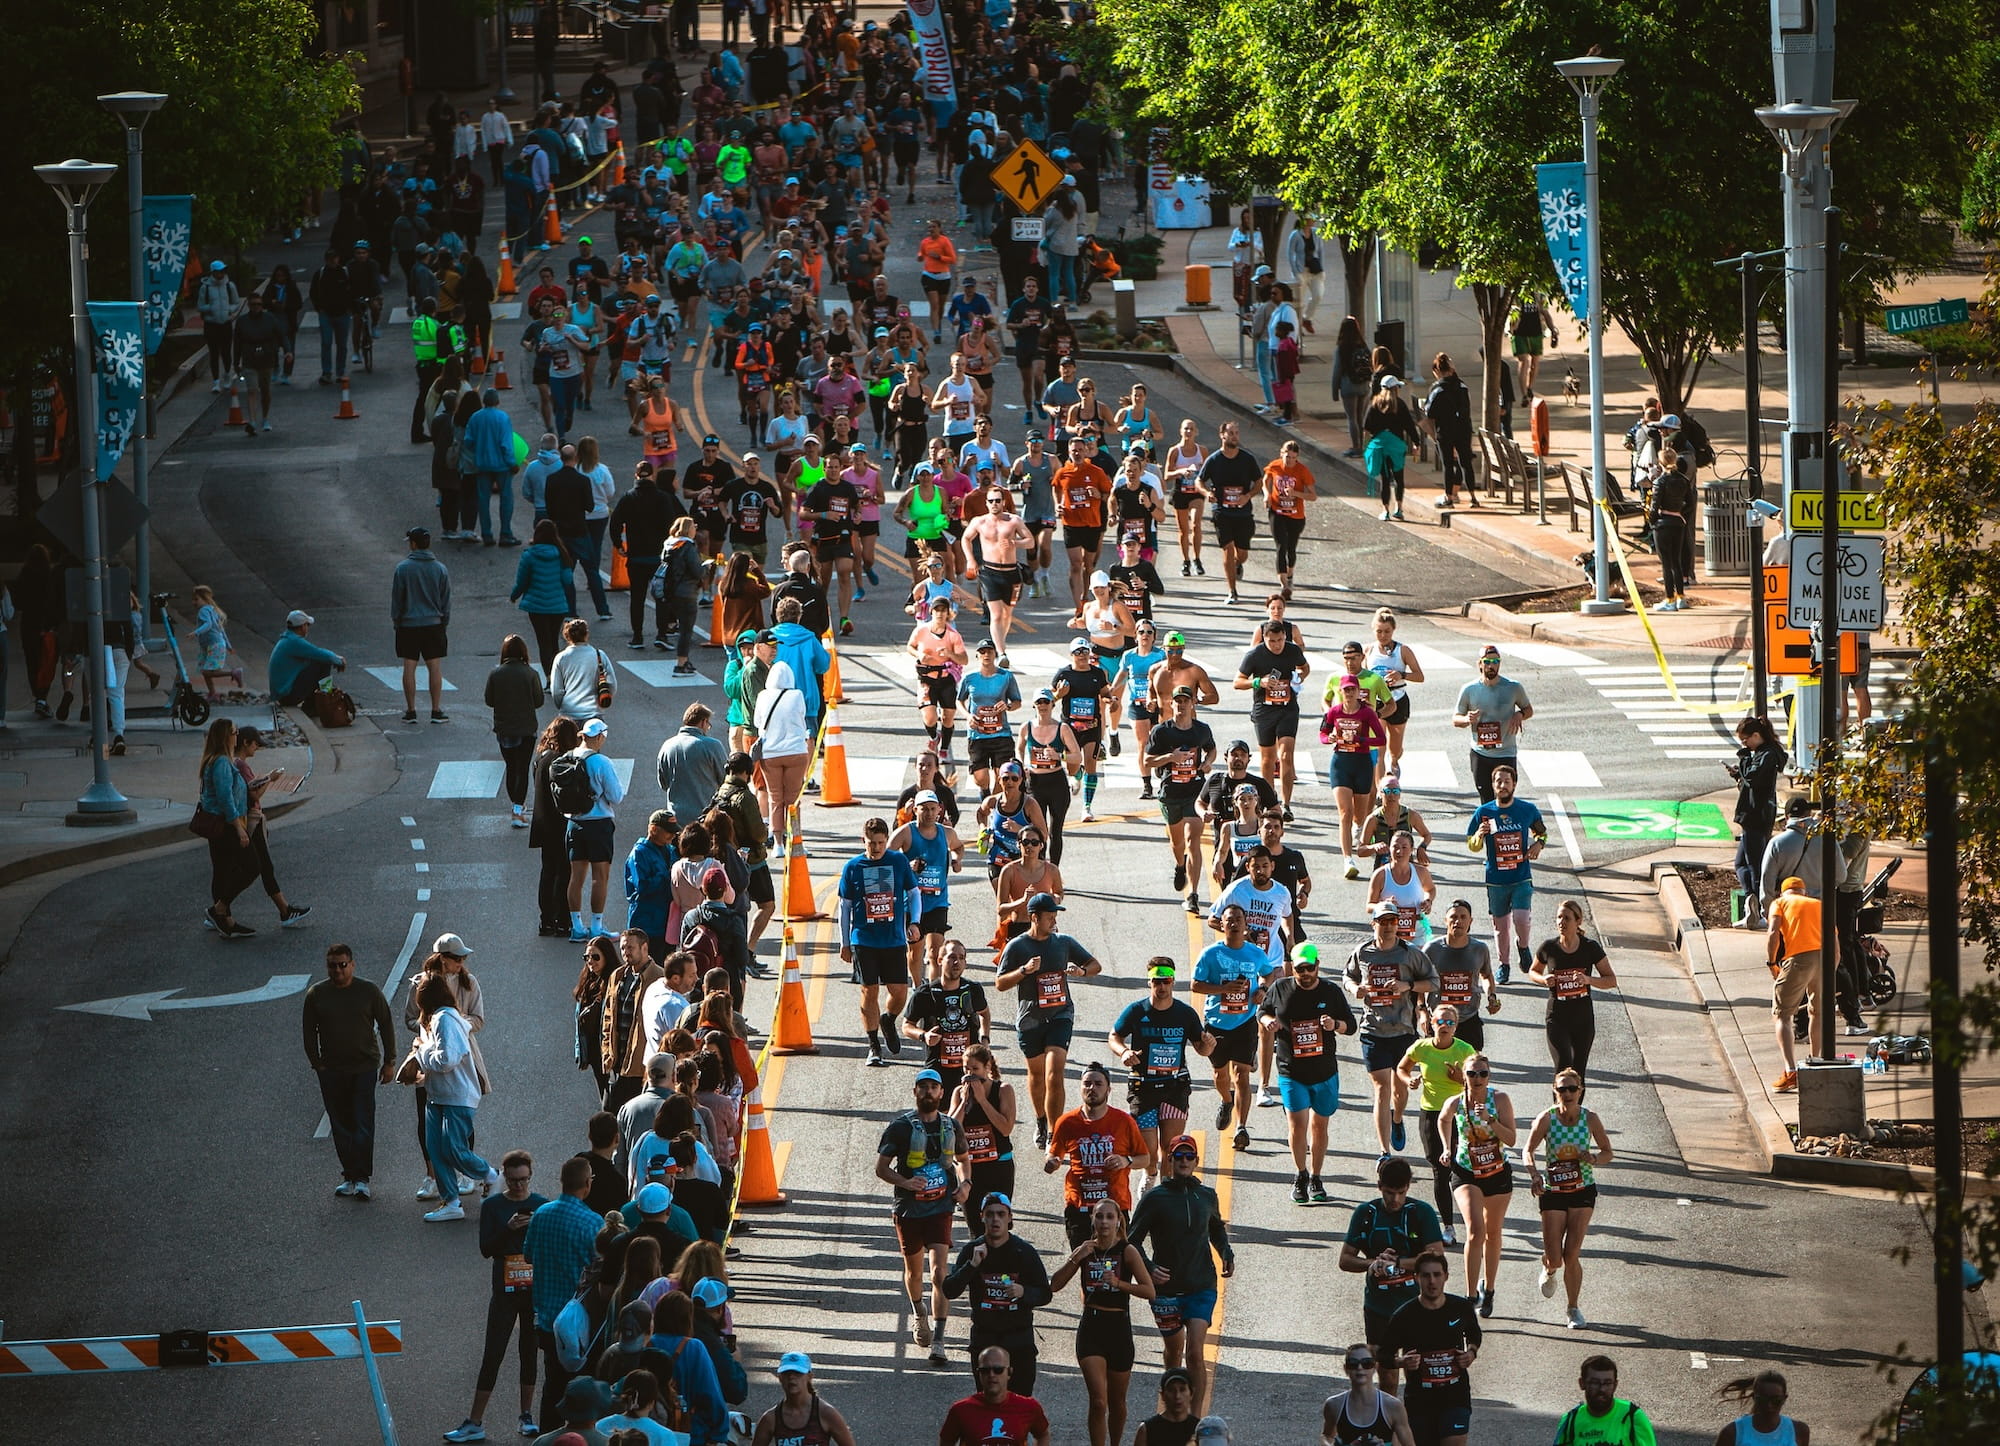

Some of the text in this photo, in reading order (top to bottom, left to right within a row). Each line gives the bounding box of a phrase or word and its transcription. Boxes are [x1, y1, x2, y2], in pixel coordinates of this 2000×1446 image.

[920, 28, 952, 95] RUMBLE
[1566, 191, 1582, 296] GULCH
[148, 225, 163, 328] GULCH
[1891, 305, 1964, 331] LAUREL ST
[100, 333, 121, 451] GULCH
[1801, 500, 1876, 521] NOICE
[1802, 584, 1870, 600] MA USE
[1794, 607, 1877, 623] FUL LANE
[1496, 820, 1522, 831] ANSAS
[1498, 843, 1520, 852] 14142
[1250, 898, 1274, 912] 1907
[1444, 982, 1469, 991] 14805
[1297, 1033, 1318, 1043] 2338
[1153, 1055, 1177, 1065] 21917
[969, 1137, 990, 1148] 2759
[1079, 1141, 1114, 1155] NASH
[1082, 1154, 1105, 1166] VILL
[1083, 1190, 1108, 1200] 14126
[1428, 1366, 1453, 1376] 1592
